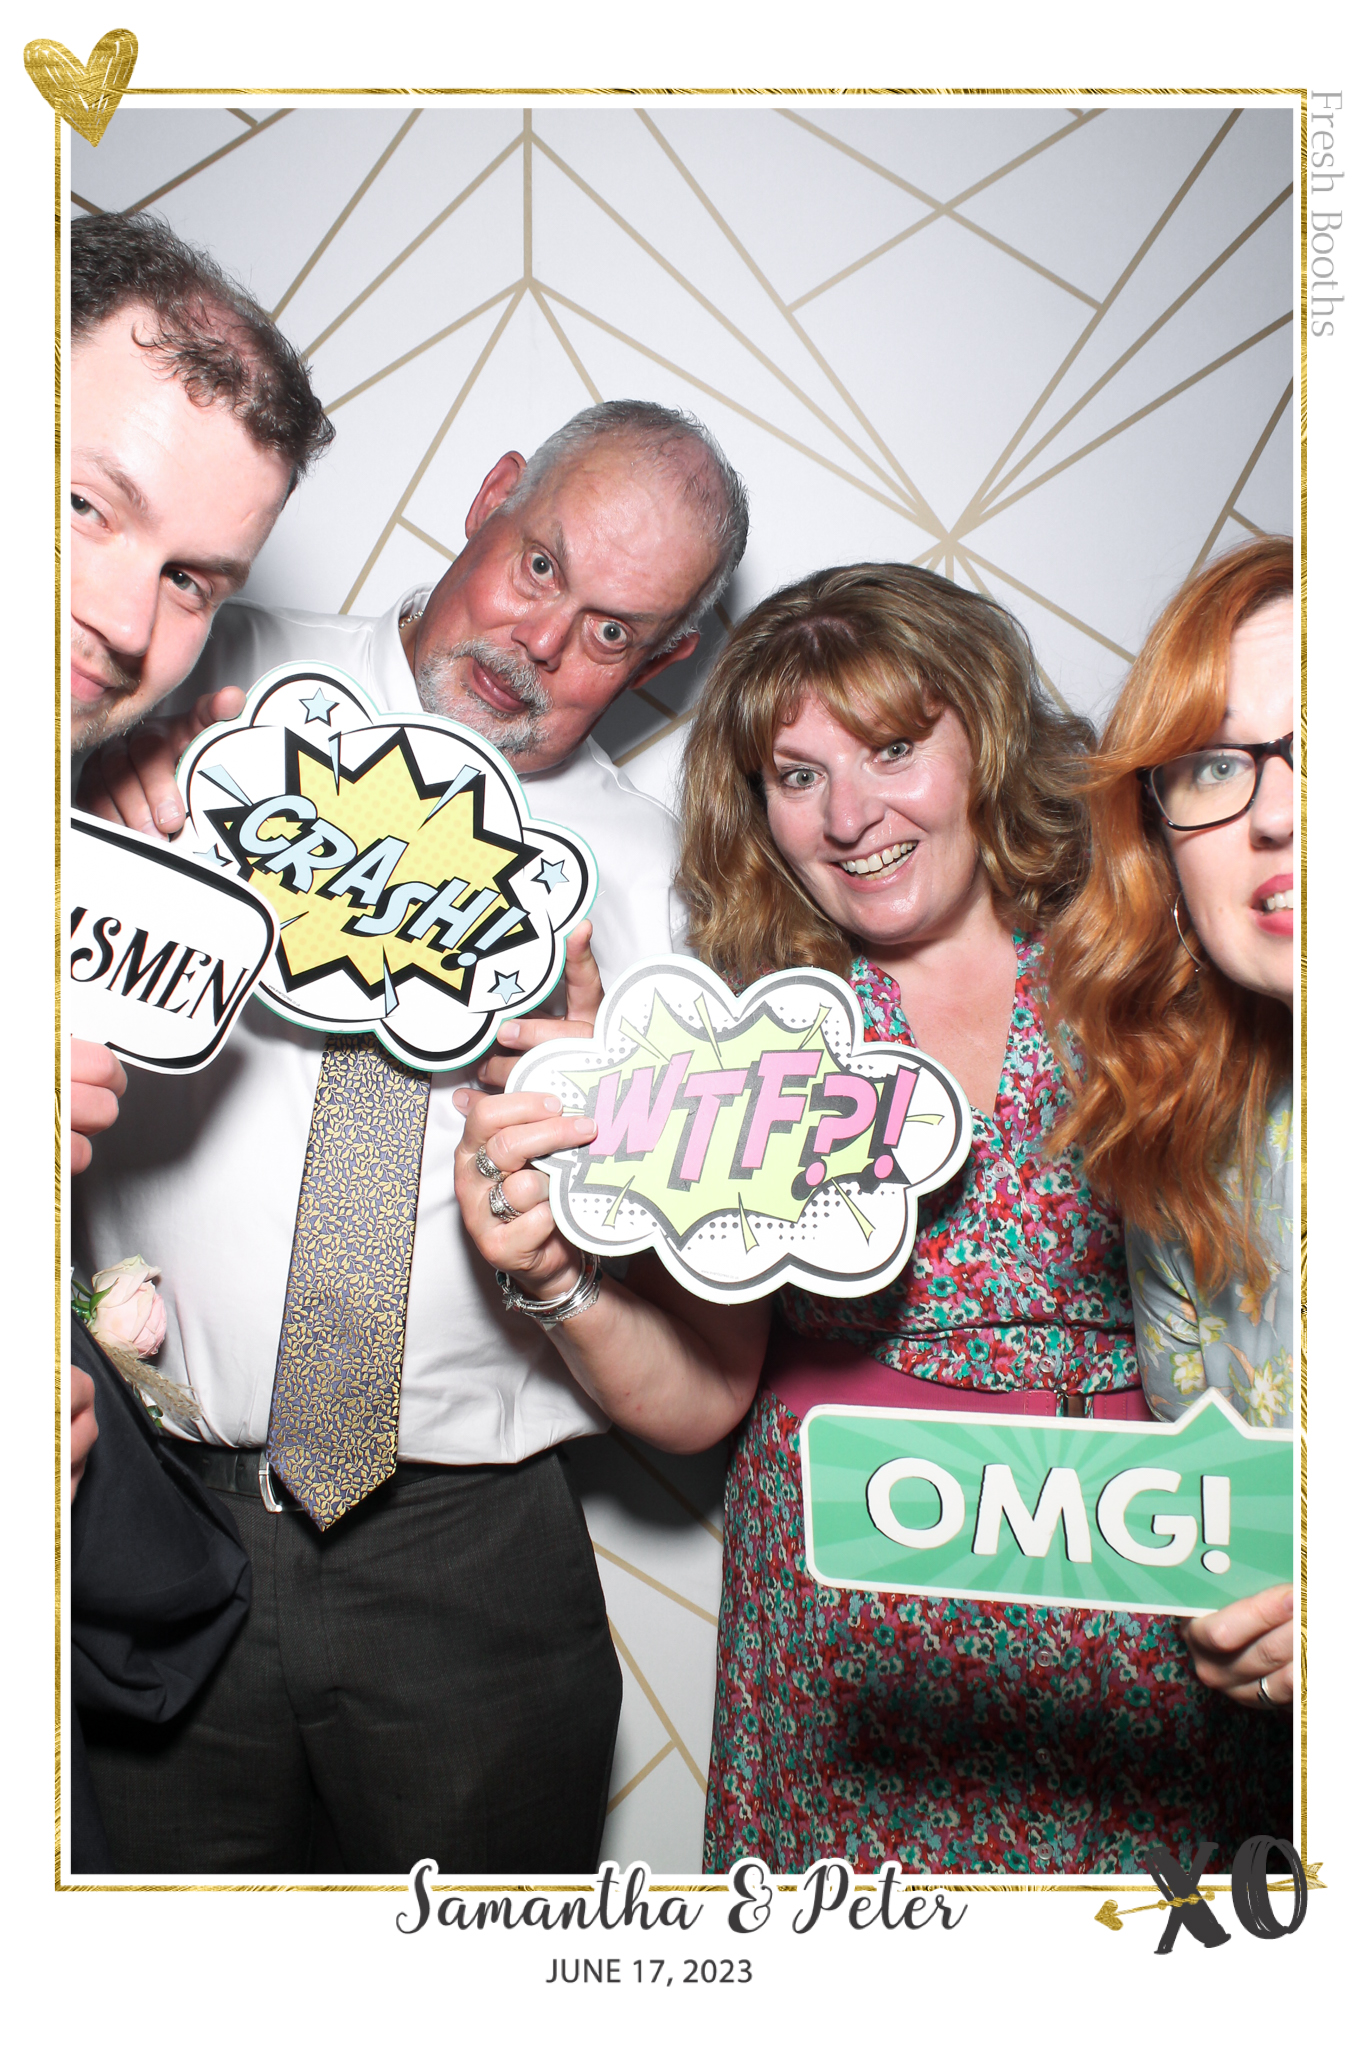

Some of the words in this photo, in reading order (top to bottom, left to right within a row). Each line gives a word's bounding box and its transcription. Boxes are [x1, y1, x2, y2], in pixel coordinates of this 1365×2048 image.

[238, 794, 531, 972] CRASH!
[580, 1048, 923, 1200] WTF?!
[865, 1456, 1232, 1575] OMG!
